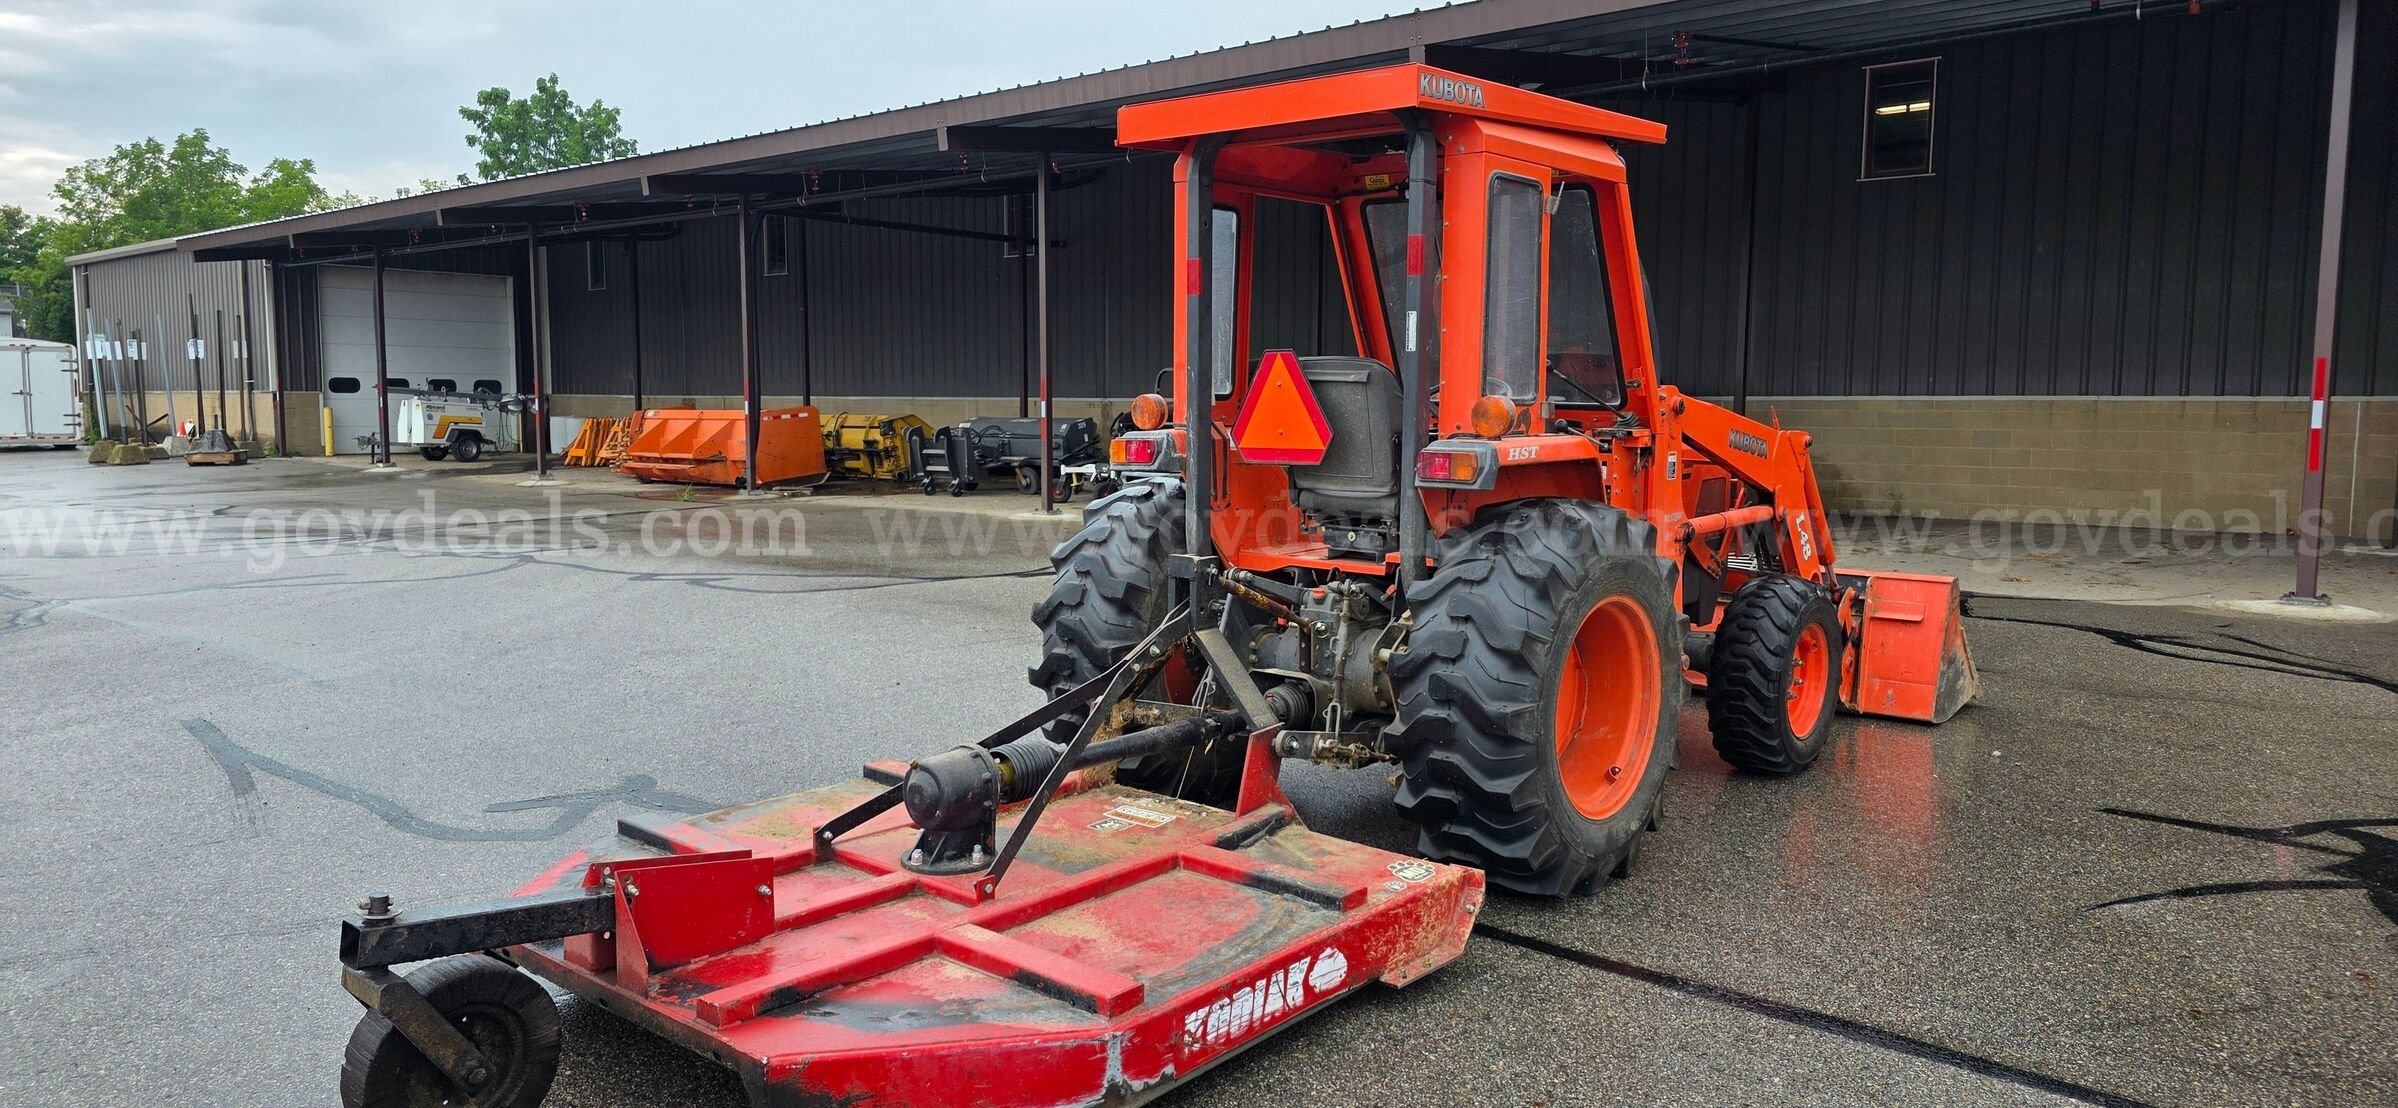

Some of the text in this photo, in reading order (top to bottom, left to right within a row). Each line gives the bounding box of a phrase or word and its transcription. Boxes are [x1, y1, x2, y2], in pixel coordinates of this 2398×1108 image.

[1420, 72, 1485, 108] KUBOTA
[1507, 446, 1539, 461] HST
[1728, 428, 1768, 459] KUBOTA
[1795, 512, 1811, 561] L48
